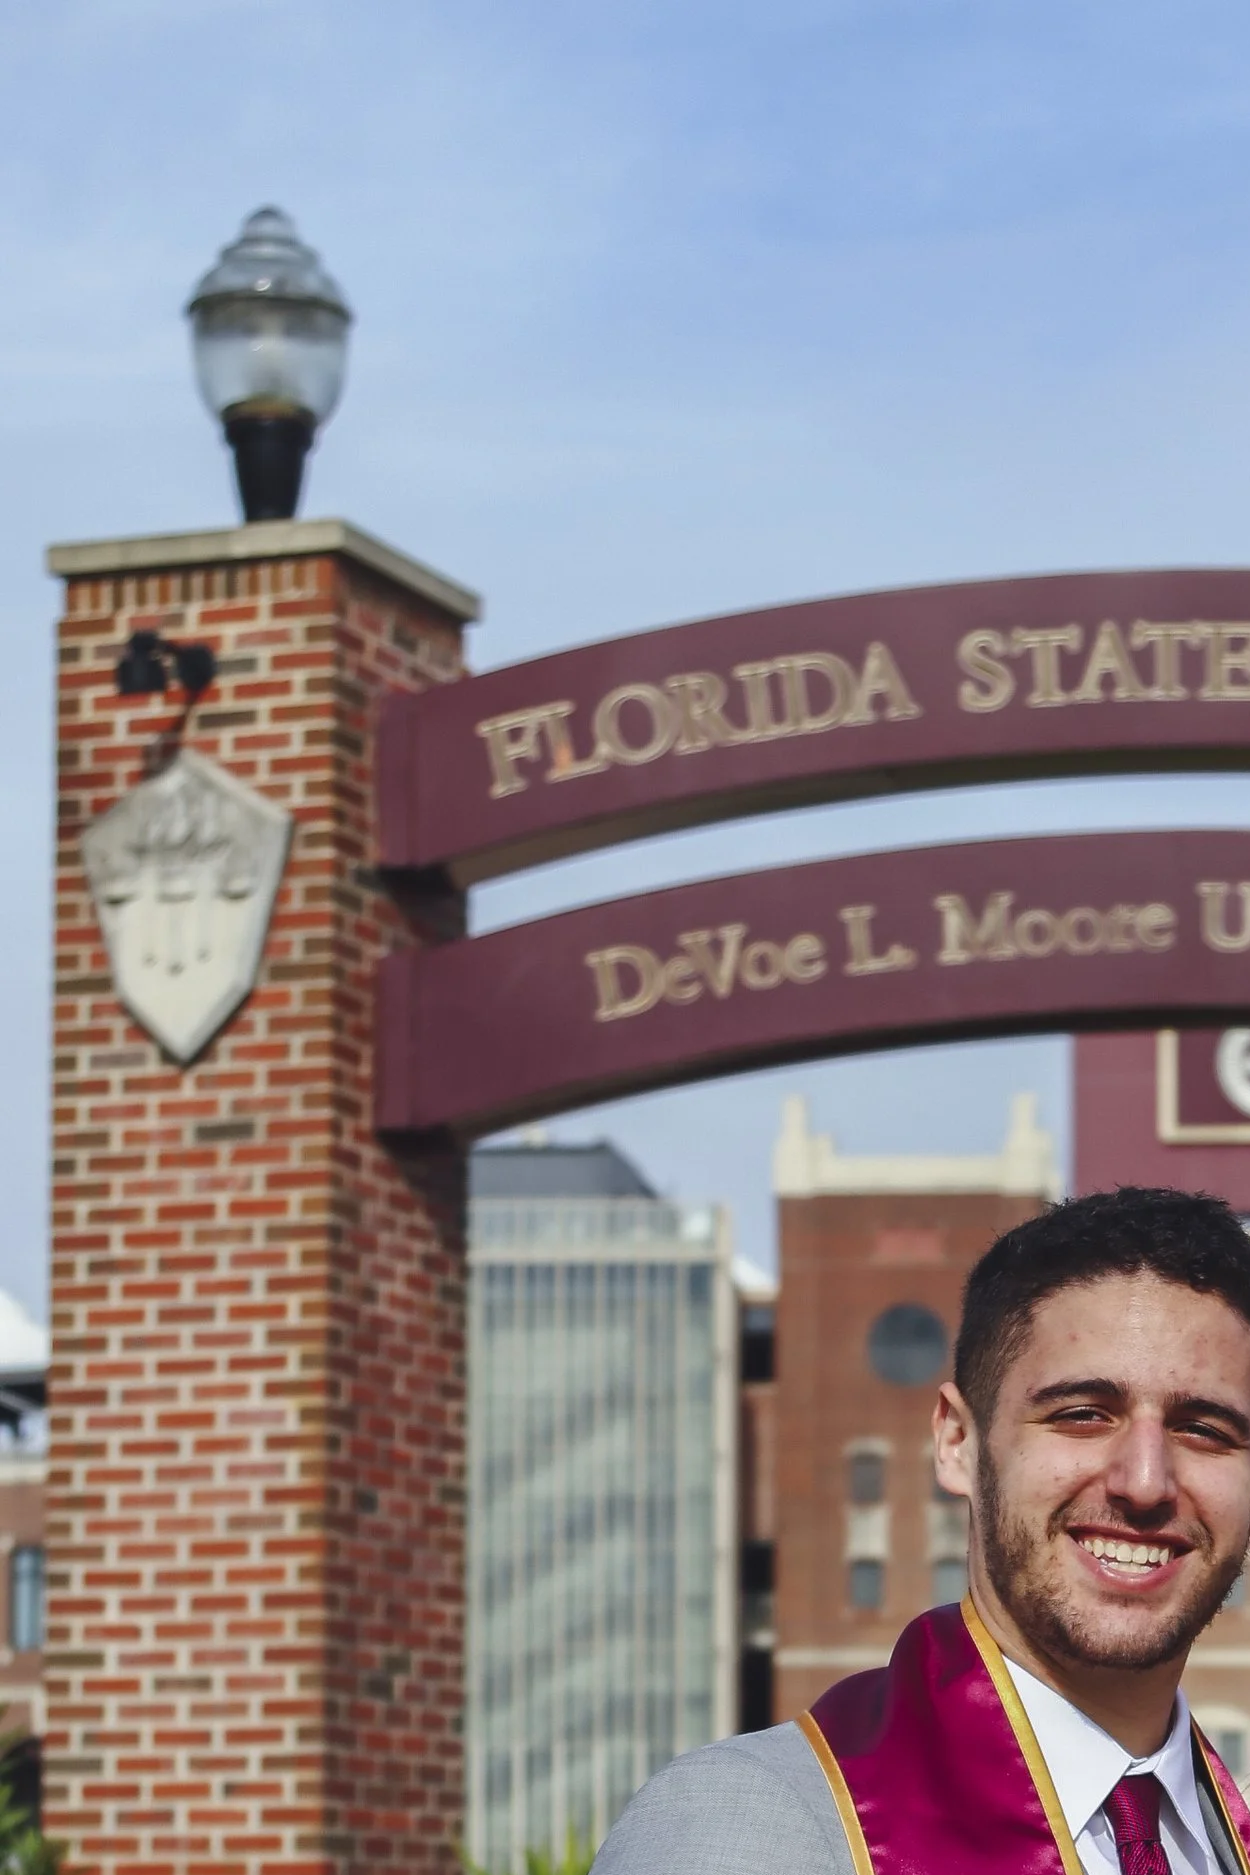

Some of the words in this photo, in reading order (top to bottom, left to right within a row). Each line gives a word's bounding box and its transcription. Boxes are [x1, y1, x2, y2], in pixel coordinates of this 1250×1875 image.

[476, 642, 921, 799] FLORIDA
[586, 923, 826, 1023] DeVoe
[840, 905, 916, 974] L.
[935, 891, 1176, 965] Moore
